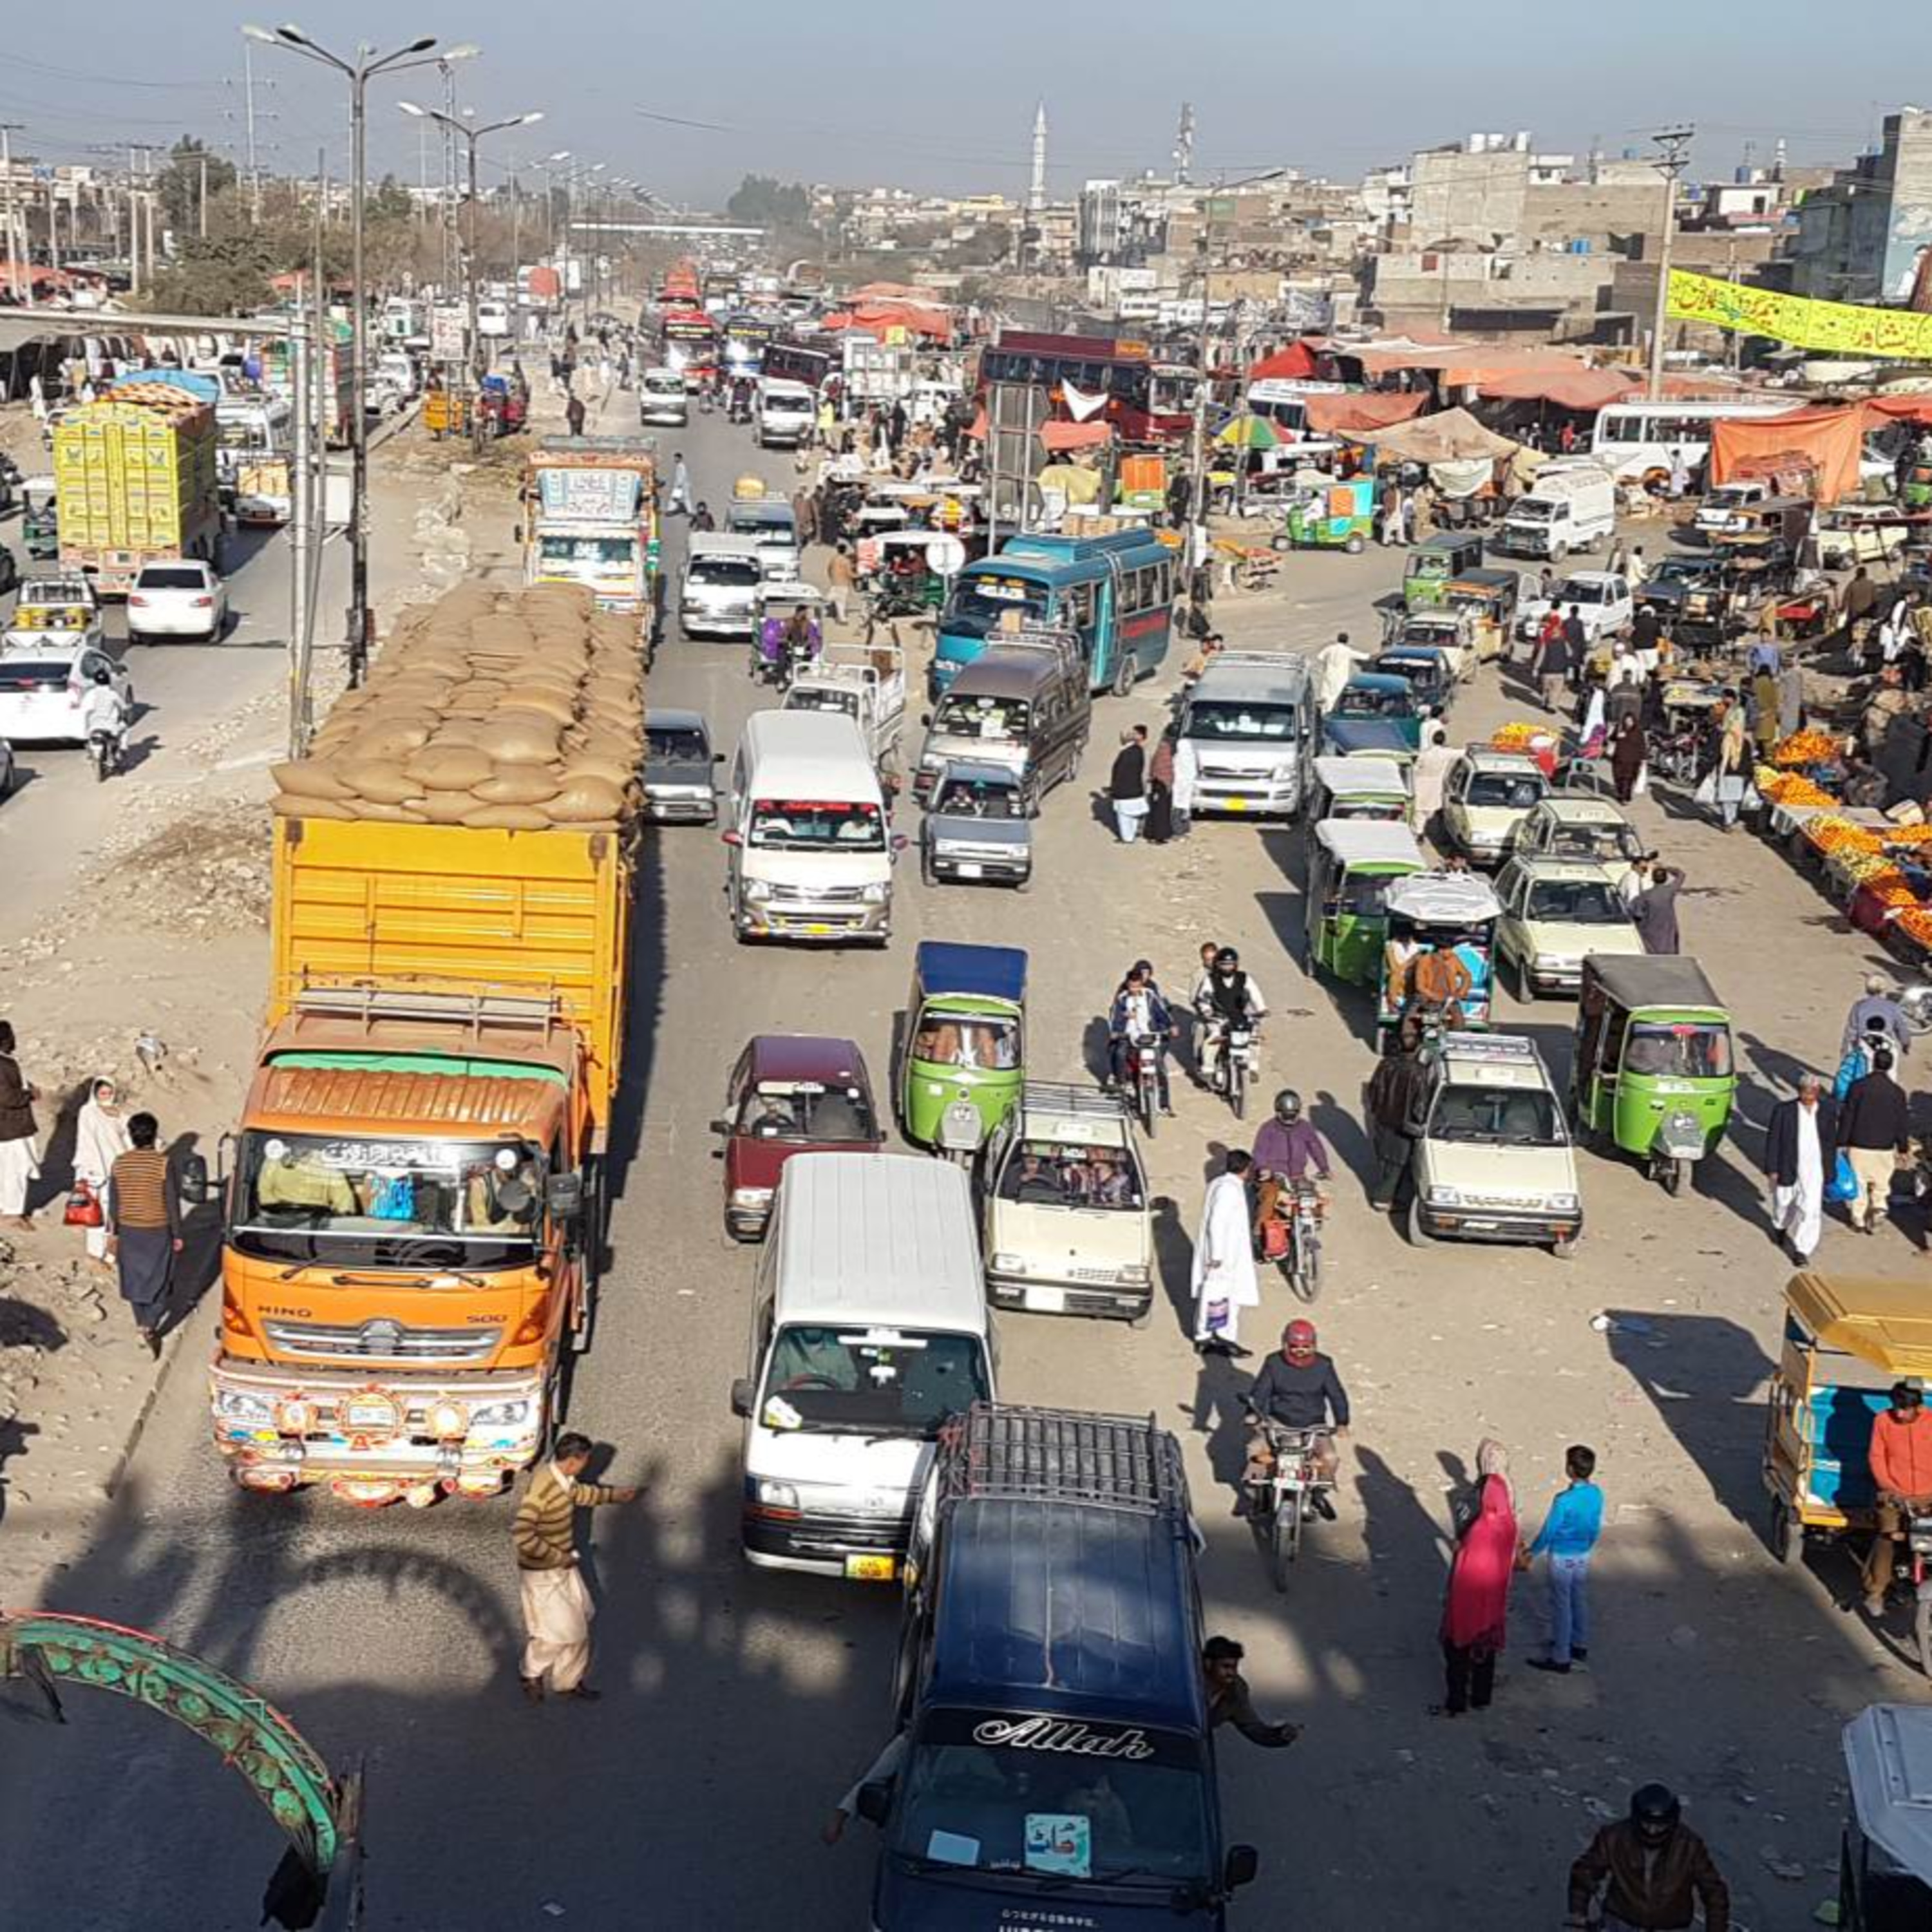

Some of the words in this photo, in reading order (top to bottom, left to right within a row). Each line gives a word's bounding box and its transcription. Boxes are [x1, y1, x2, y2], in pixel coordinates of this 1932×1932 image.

[258, 1305, 313, 1318] HINO
[466, 1314, 509, 1324] 500
[972, 1718, 1155, 1759] Allah
